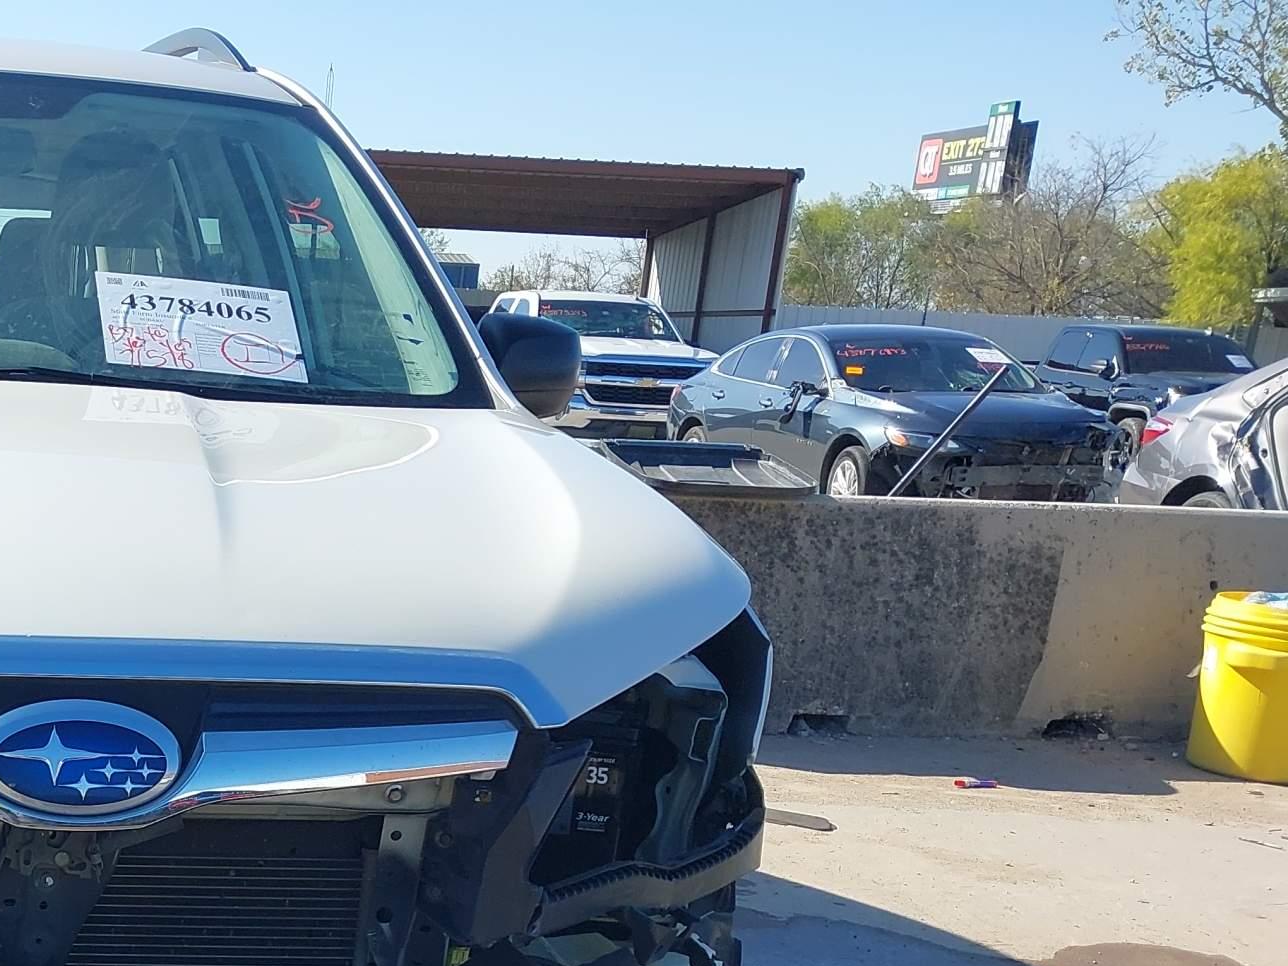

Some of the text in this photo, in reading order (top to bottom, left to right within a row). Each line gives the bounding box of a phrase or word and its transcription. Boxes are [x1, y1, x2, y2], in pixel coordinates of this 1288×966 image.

[942, 141, 967, 160] EXIT
[120, 292, 273, 325] 43784065
[585, 766, 609, 785] 35
[576, 811, 610, 823] 3-Year
